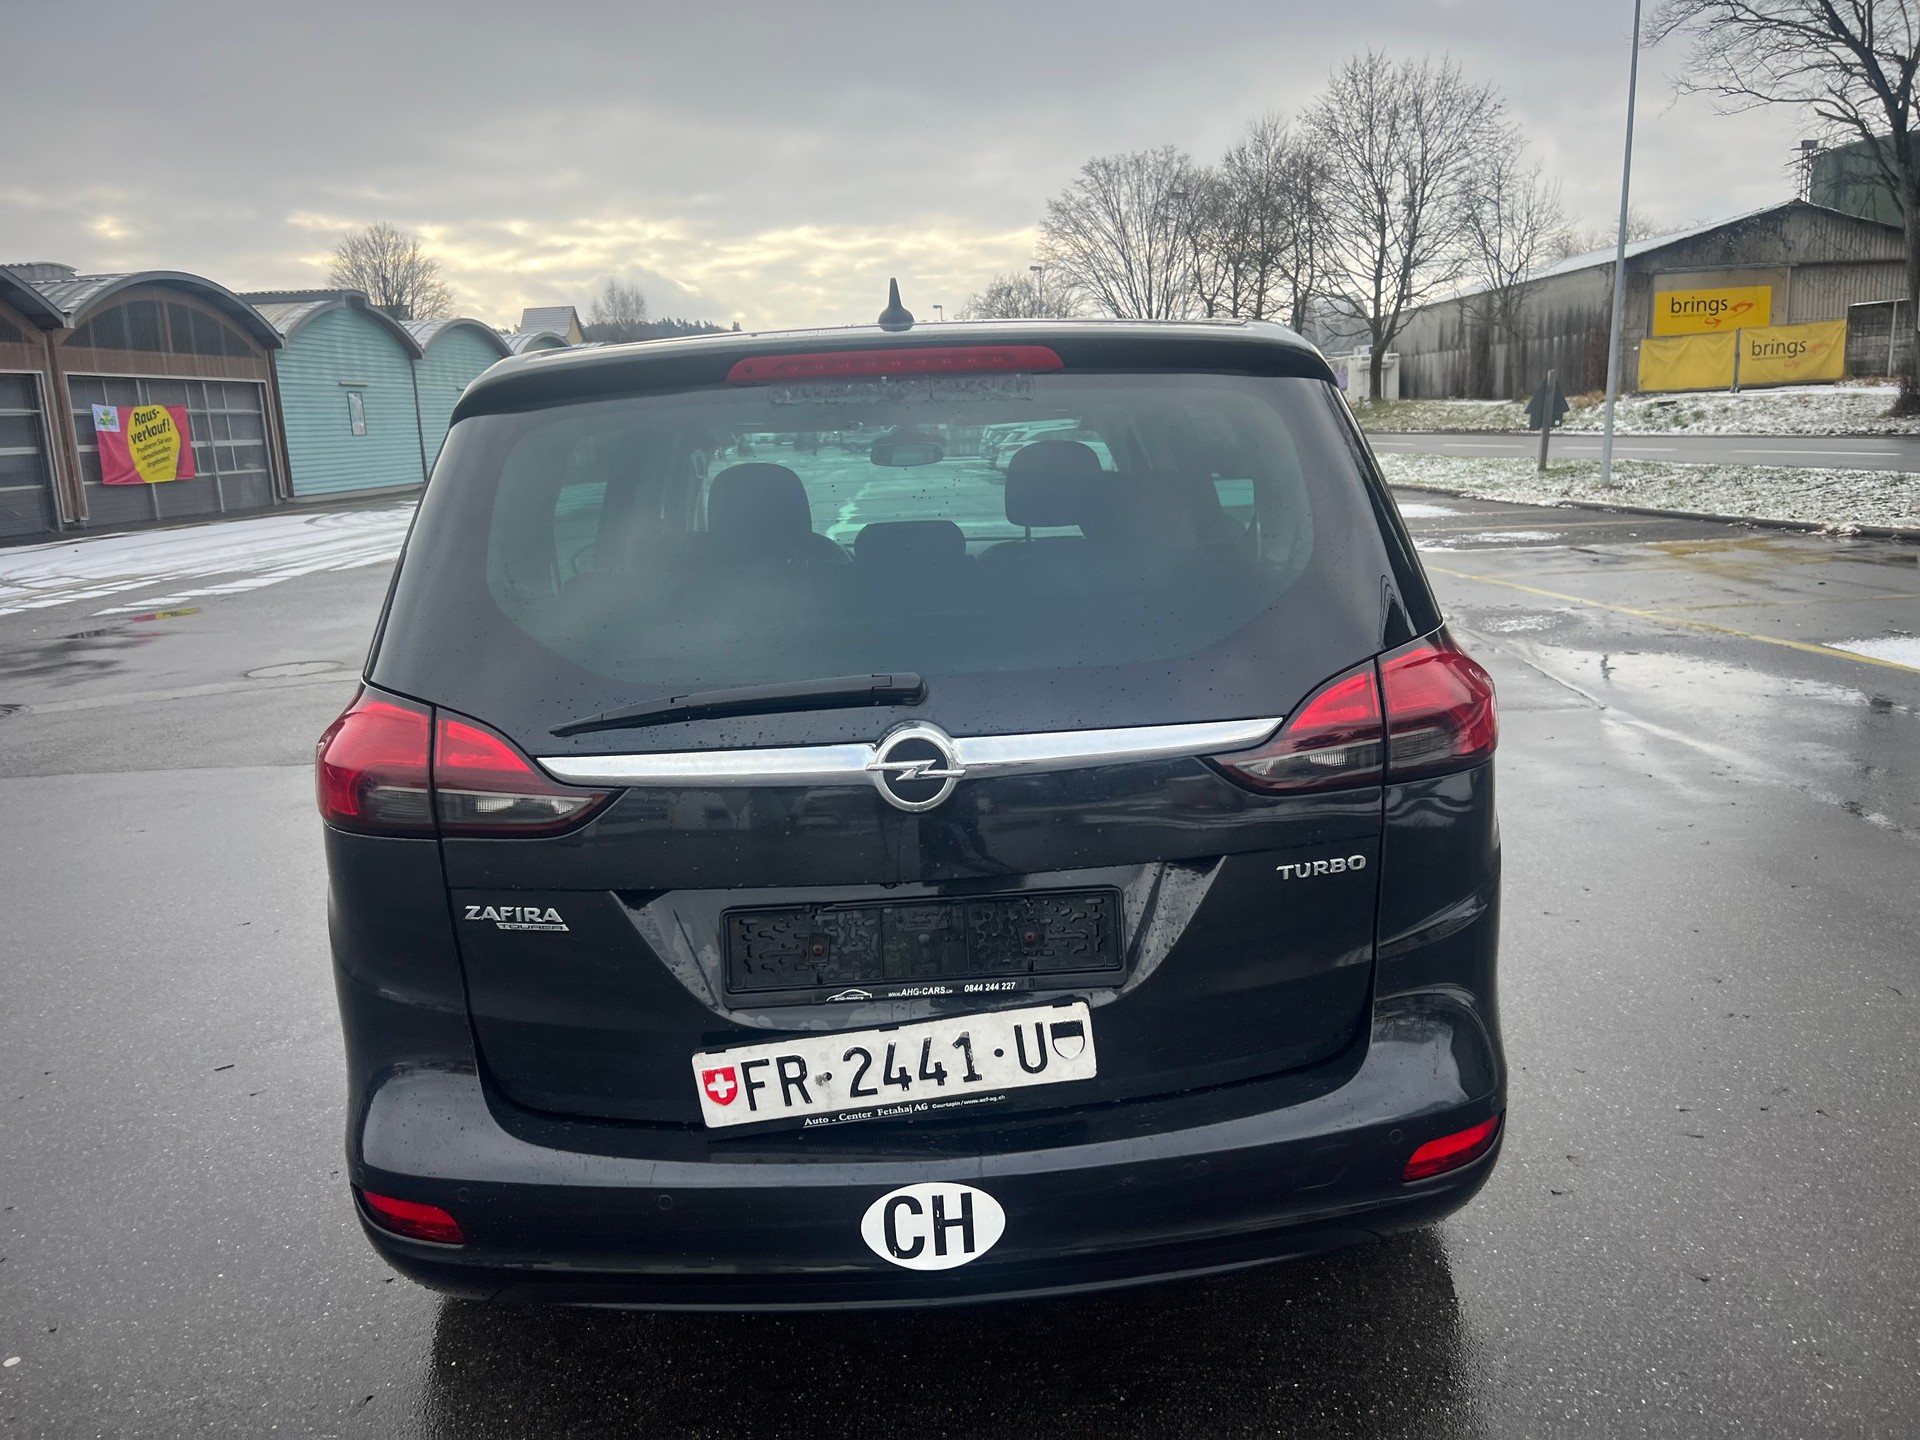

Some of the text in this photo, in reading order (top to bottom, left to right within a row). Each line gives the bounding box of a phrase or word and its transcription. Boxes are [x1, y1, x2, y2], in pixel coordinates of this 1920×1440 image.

[1670, 296, 1728, 316] brings
[1751, 338, 1807, 359] brings
[134, 409, 160, 426] Raus-
[130, 418, 170, 444] verkauf!
[1276, 854, 1367, 880] TURBO
[465, 905, 563, 923] ZAFIRA
[498, 923, 565, 931] TOURER
[964, 984, 983, 993] 0844
[985, 982, 999, 992] 244
[1001, 982, 1016, 991] 227
[803, 1117, 829, 1126] Auto
[838, 1111, 872, 1122] Center
[876, 1104, 914, 1116] Fetahaj
[914, 1102, 929, 1112] AG
[883, 1192, 976, 1260] CH
